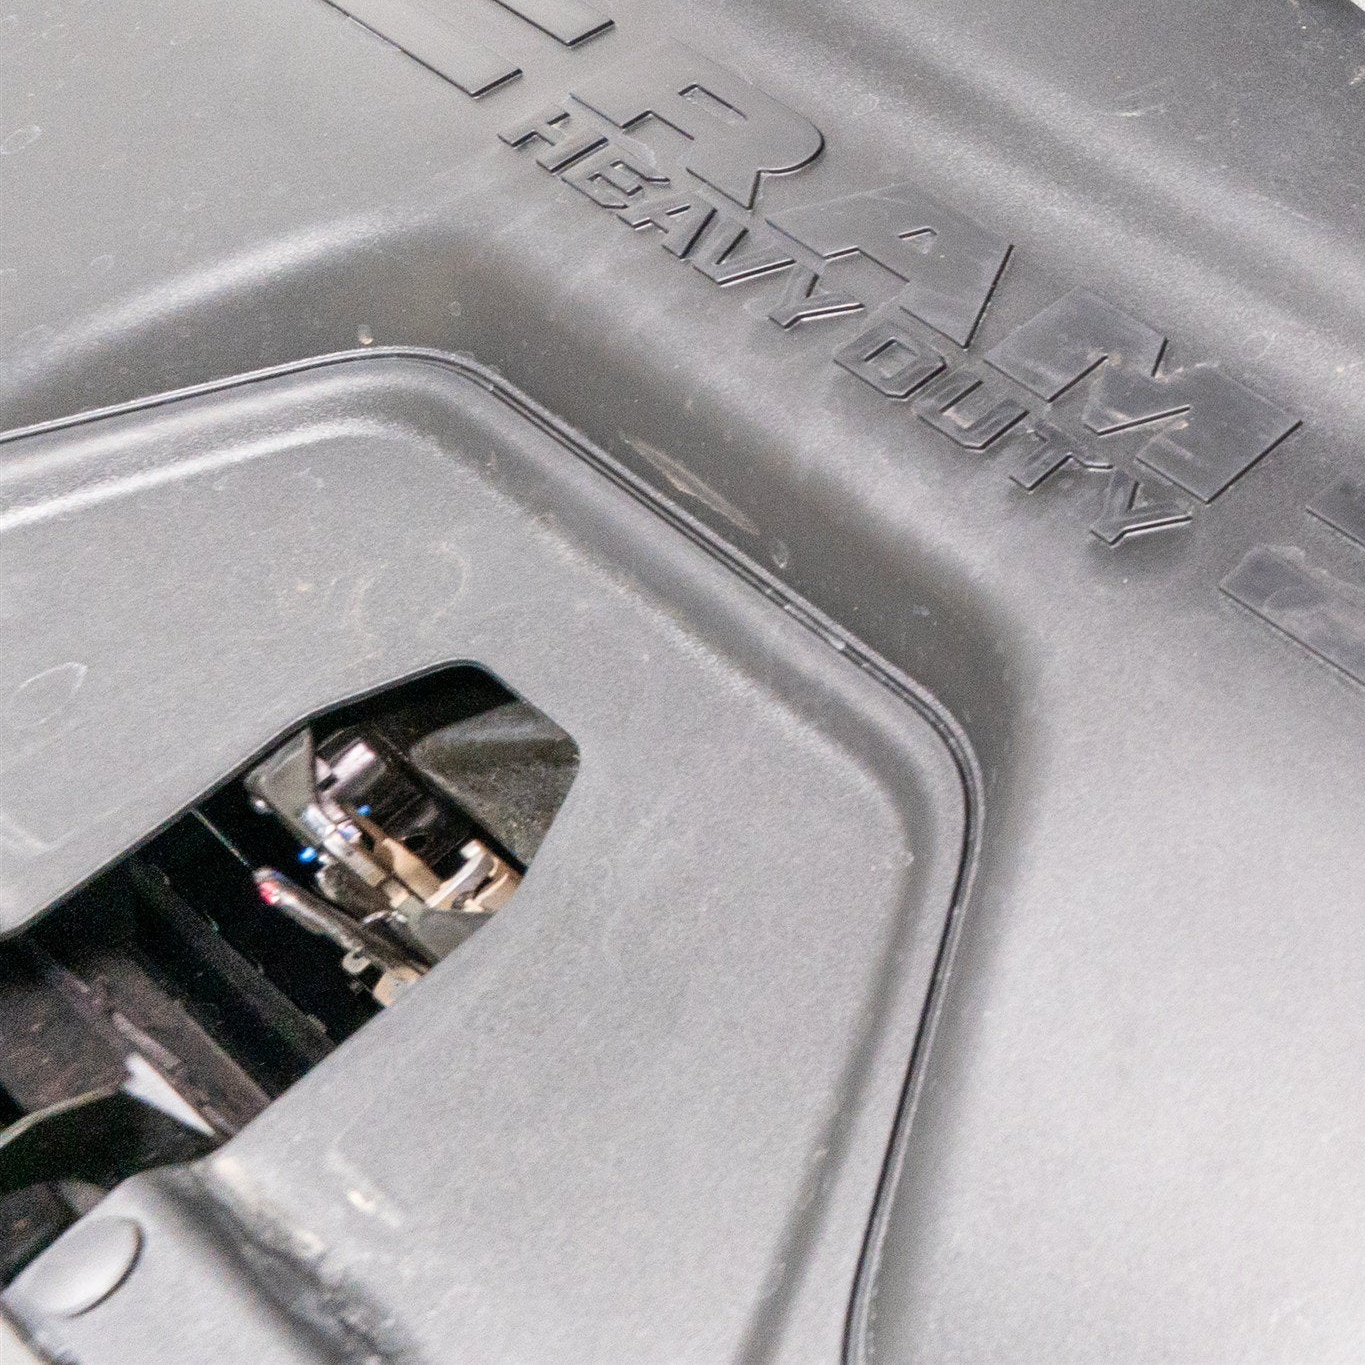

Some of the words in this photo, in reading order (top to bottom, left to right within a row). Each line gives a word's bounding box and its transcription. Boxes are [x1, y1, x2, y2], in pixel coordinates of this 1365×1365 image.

[498, 109, 865, 331] HEAVY
[833, 317, 1194, 550] DUTY
[569, 39, 1304, 505] RAM
